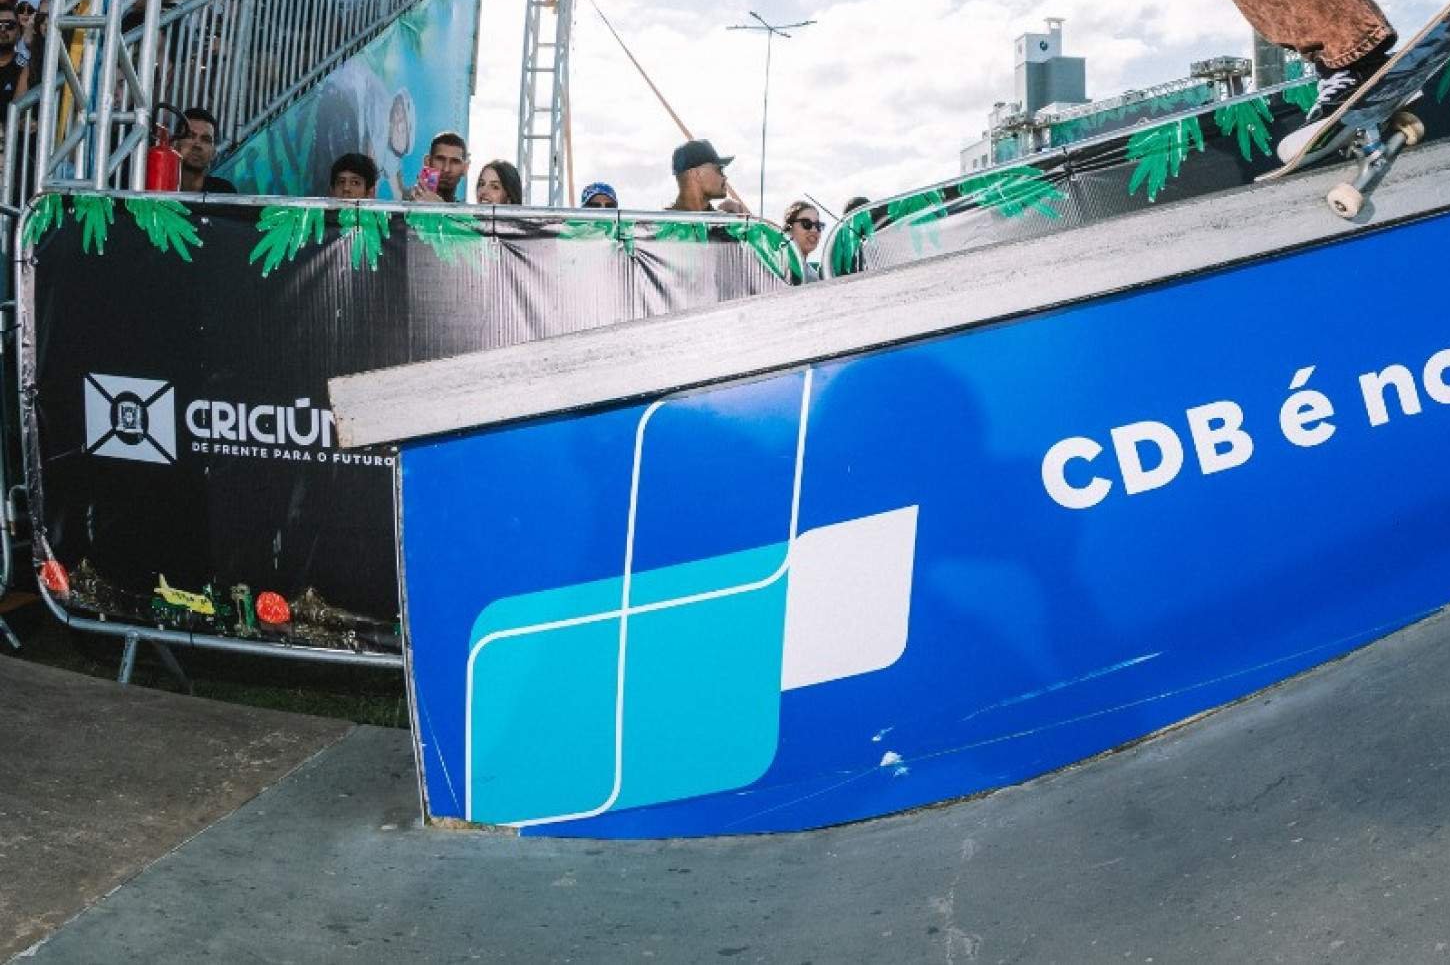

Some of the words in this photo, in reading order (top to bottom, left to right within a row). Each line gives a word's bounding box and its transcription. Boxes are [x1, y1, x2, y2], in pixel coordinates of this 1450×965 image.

[185, 397, 336, 448] CRICIÚ
[1042, 402, 1253, 509] CDB
[1279, 366, 1336, 447] é
[191, 442, 209, 453] DE
[213, 444, 268, 459] FRENTE
[273, 448, 311, 461] PARA
[316, 451, 327, 463] O
[332, 453, 394, 466] FUTURO
